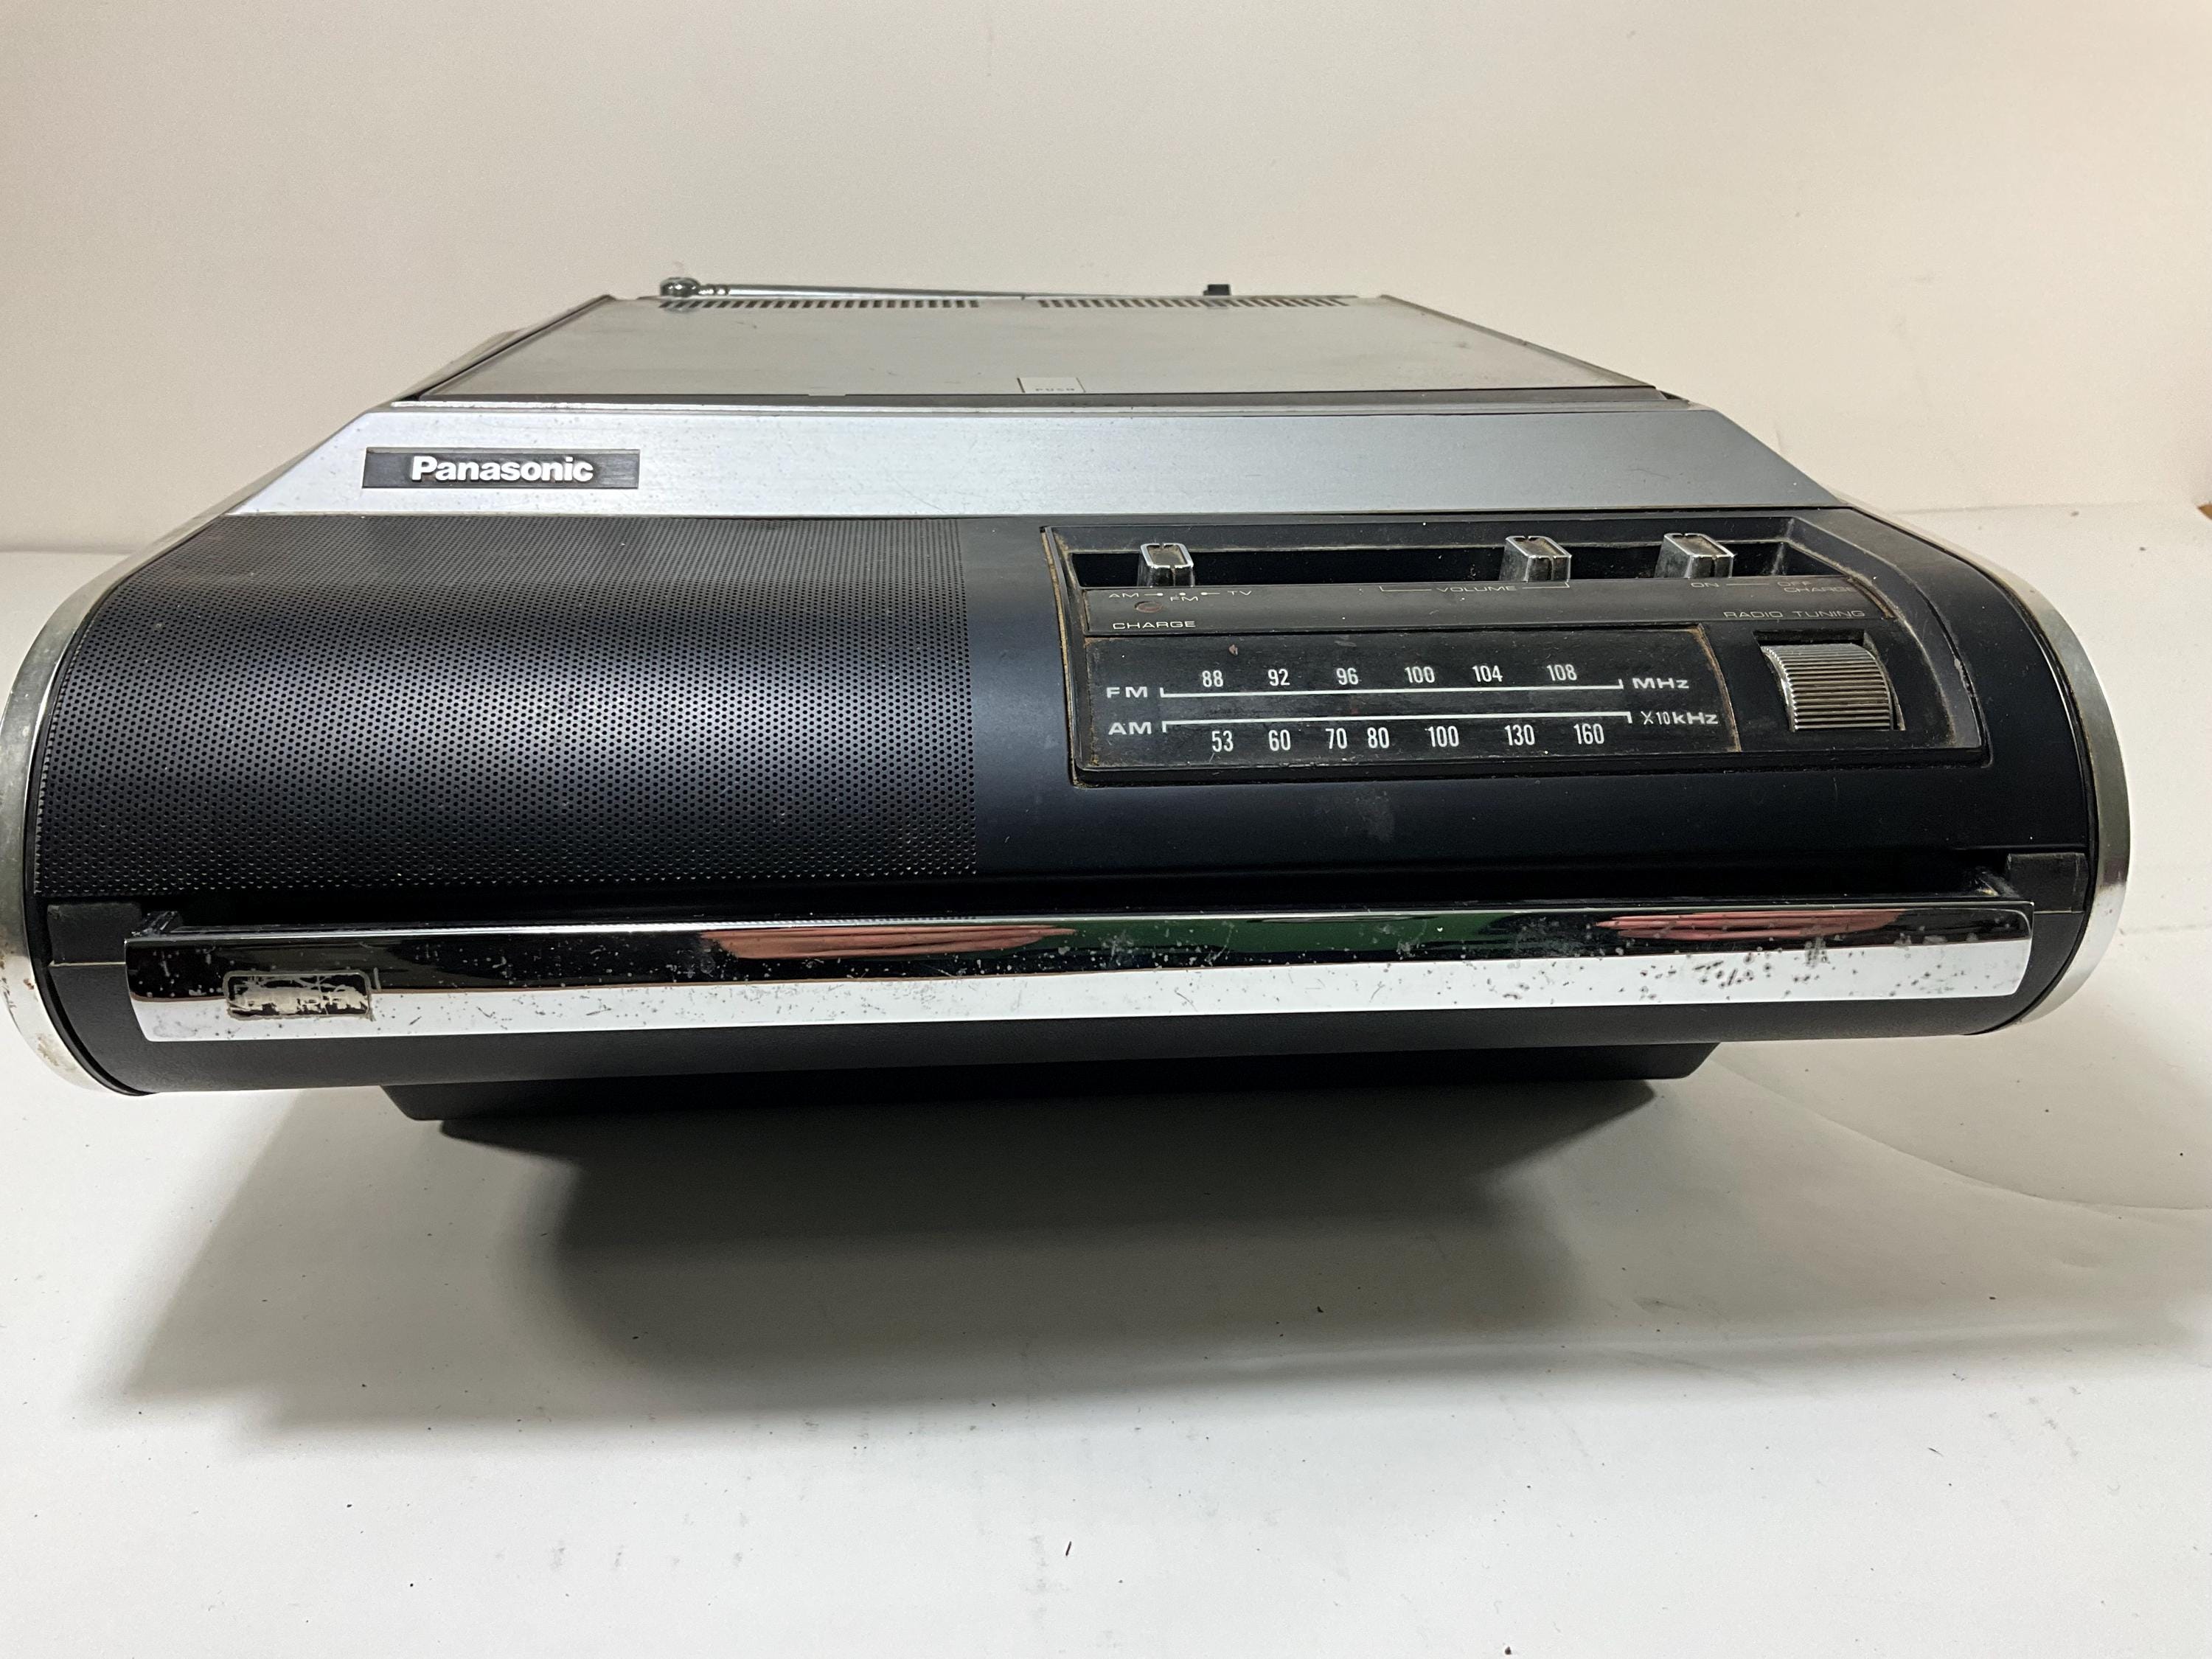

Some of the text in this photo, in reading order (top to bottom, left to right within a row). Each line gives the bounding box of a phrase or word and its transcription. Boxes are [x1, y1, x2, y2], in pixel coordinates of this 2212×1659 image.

[411, 456, 594, 481] Panasonic
[1113, 621, 1196, 630] CHARGE
[1107, 664, 1689, 698] FM 88 92 96 100 104 108 MHz
[1109, 723, 1152, 734] AM
[1211, 731, 1234, 751] 53
[1268, 731, 1290, 750] 60
[1326, 728, 1347, 749] 70
[1368, 727, 1390, 748] 80
[1429, 726, 1459, 746] 100
[1504, 725, 1535, 745] 130
[1573, 723, 1604, 744] 160
